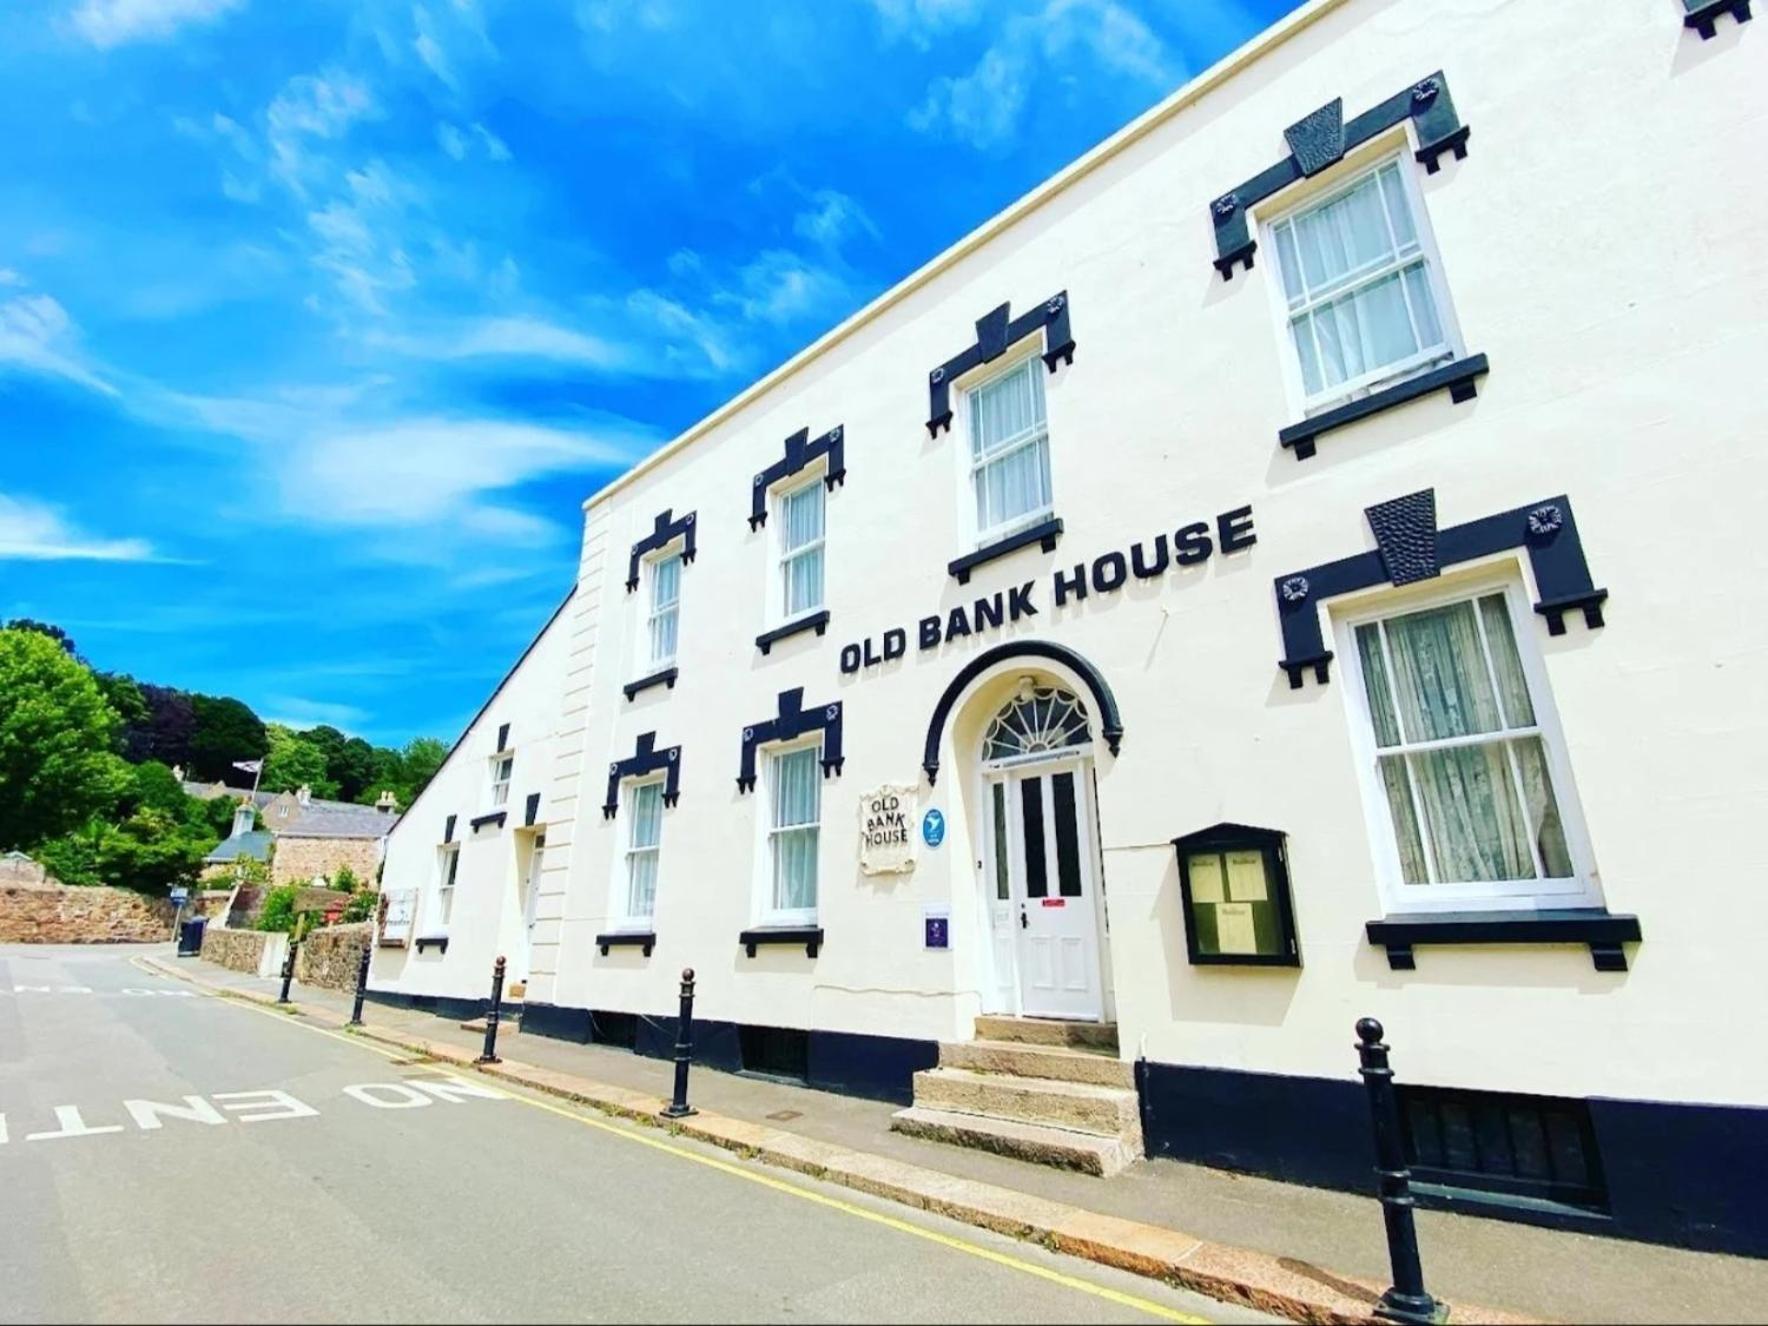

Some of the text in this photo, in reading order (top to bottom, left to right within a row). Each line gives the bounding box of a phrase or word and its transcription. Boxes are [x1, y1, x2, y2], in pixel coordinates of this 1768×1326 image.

[840, 504, 1257, 674] OLD BANK HOUSE
[871, 796, 899, 813] OLD
[867, 812, 906, 832] BANK
[865, 829, 908, 848] HOUSE
[0, 1078, 511, 1144] NO ENT
